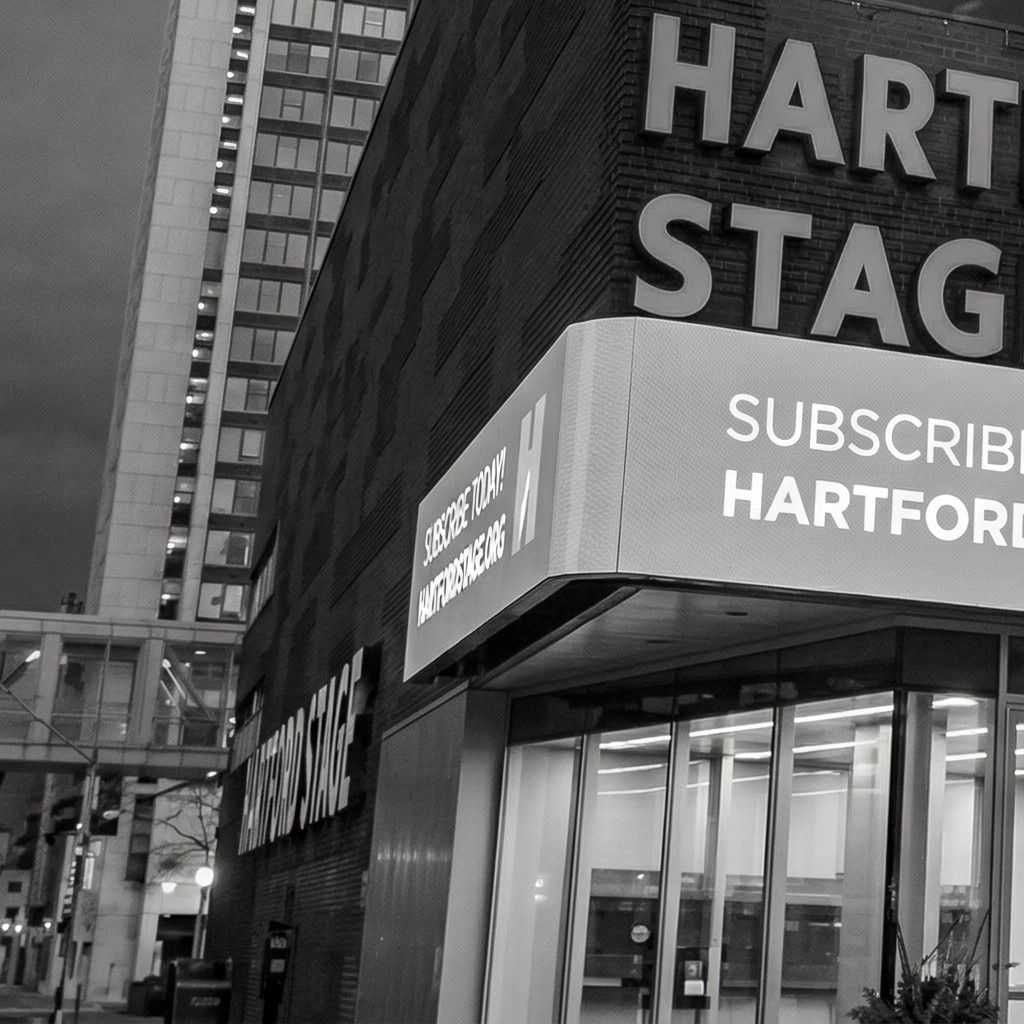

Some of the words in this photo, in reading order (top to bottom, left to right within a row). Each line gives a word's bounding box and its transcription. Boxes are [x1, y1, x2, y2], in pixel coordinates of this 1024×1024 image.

[423, 486, 471, 567] SUBSCRIBE
[472, 446, 507, 521] TODAY!
[299, 646, 364, 830] STAGE
